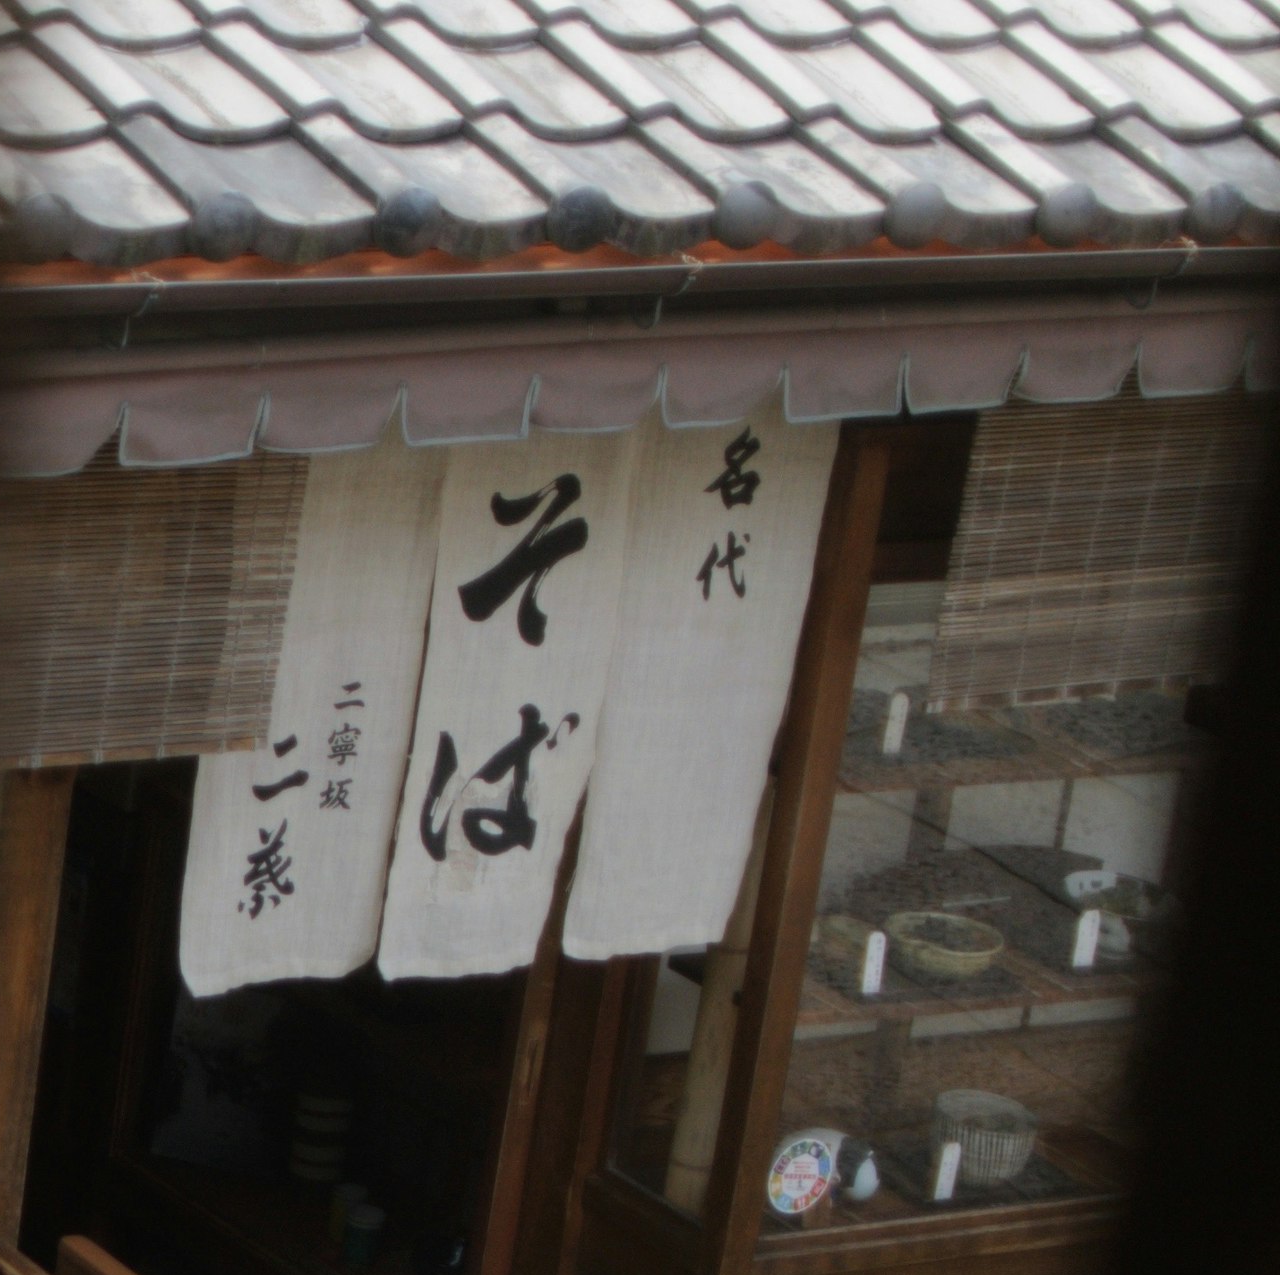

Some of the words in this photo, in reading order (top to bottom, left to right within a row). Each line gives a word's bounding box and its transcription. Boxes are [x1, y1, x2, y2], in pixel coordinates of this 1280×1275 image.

[697, 424, 763, 601] 名代
[319, 681, 366, 811] 二寧坂
[419, 472, 589, 862] そば
